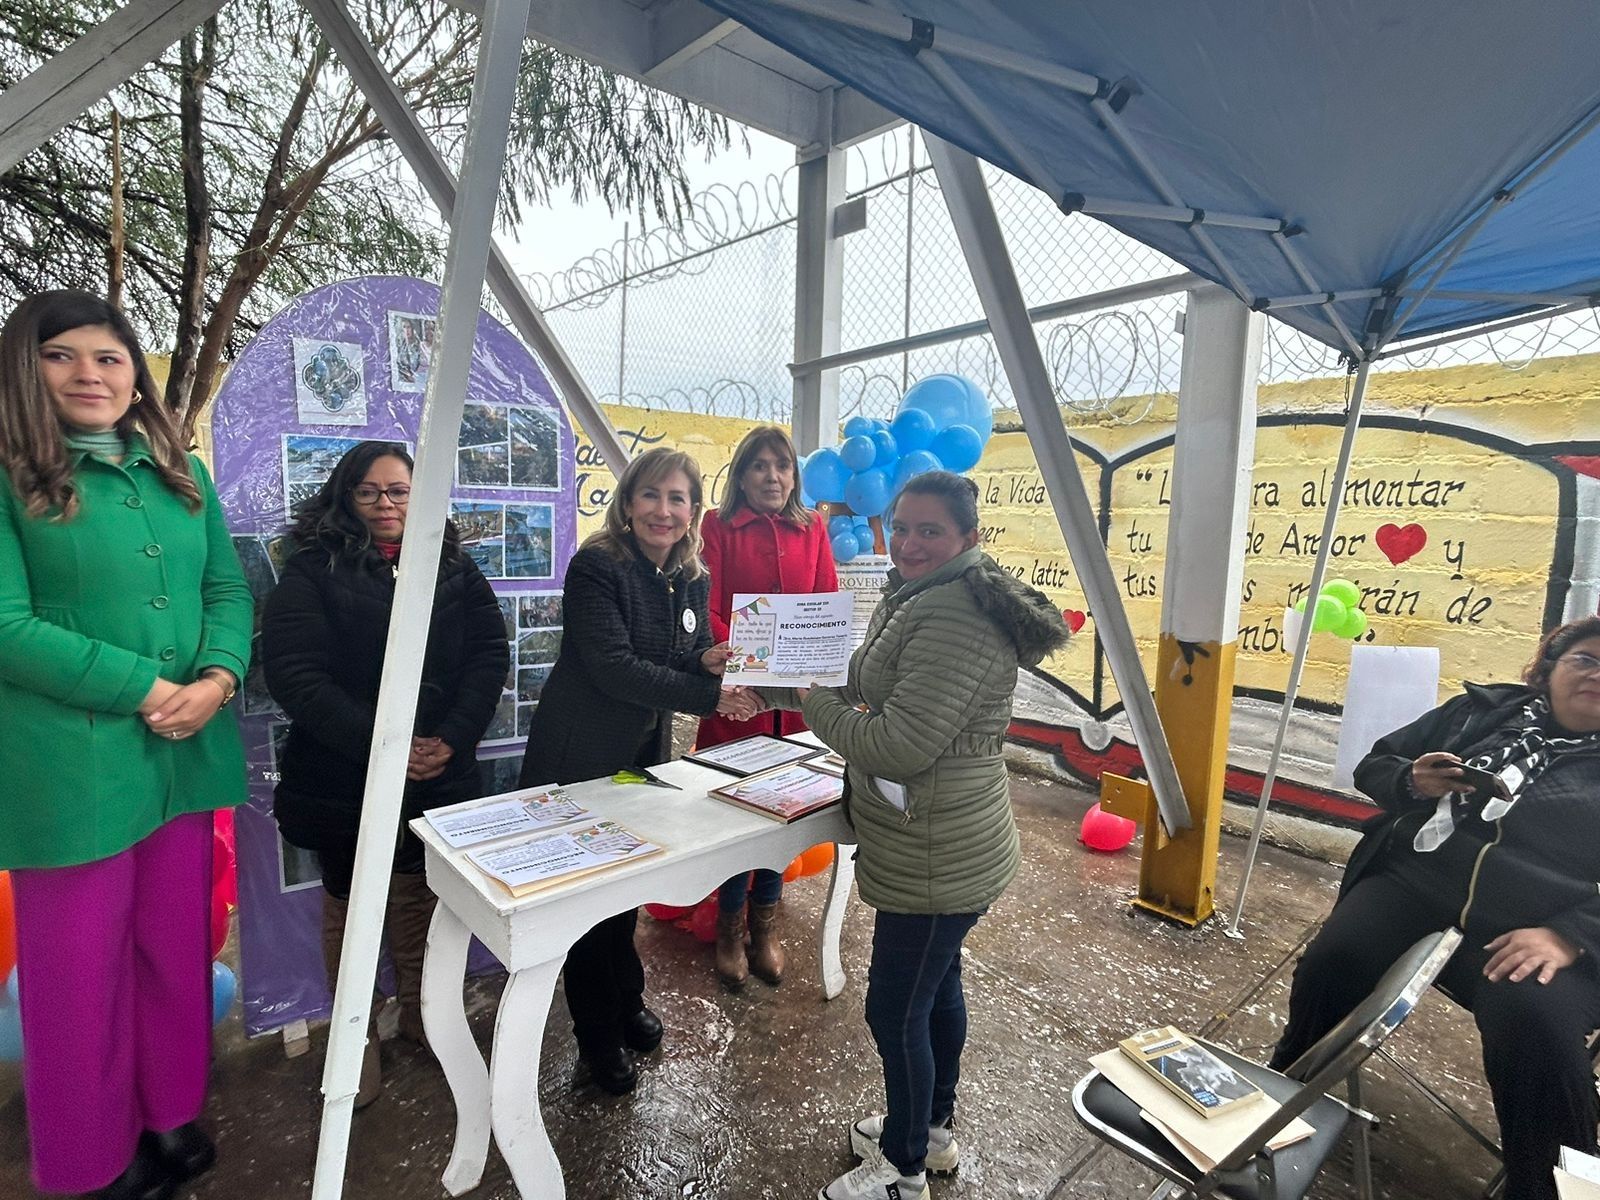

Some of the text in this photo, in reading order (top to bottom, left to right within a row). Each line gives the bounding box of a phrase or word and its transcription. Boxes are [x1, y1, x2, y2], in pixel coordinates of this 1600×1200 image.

[985, 474, 1046, 504] la Vida
[1126, 519, 1153, 554] tu
[1443, 539, 1466, 581] y
[839, 576, 887, 588] ROVER
[1031, 558, 1070, 588] latir
[1123, 564, 1157, 599] tus
[1446, 586, 1493, 625] de
[780, 620, 847, 630] RECONOCIMIENTO
